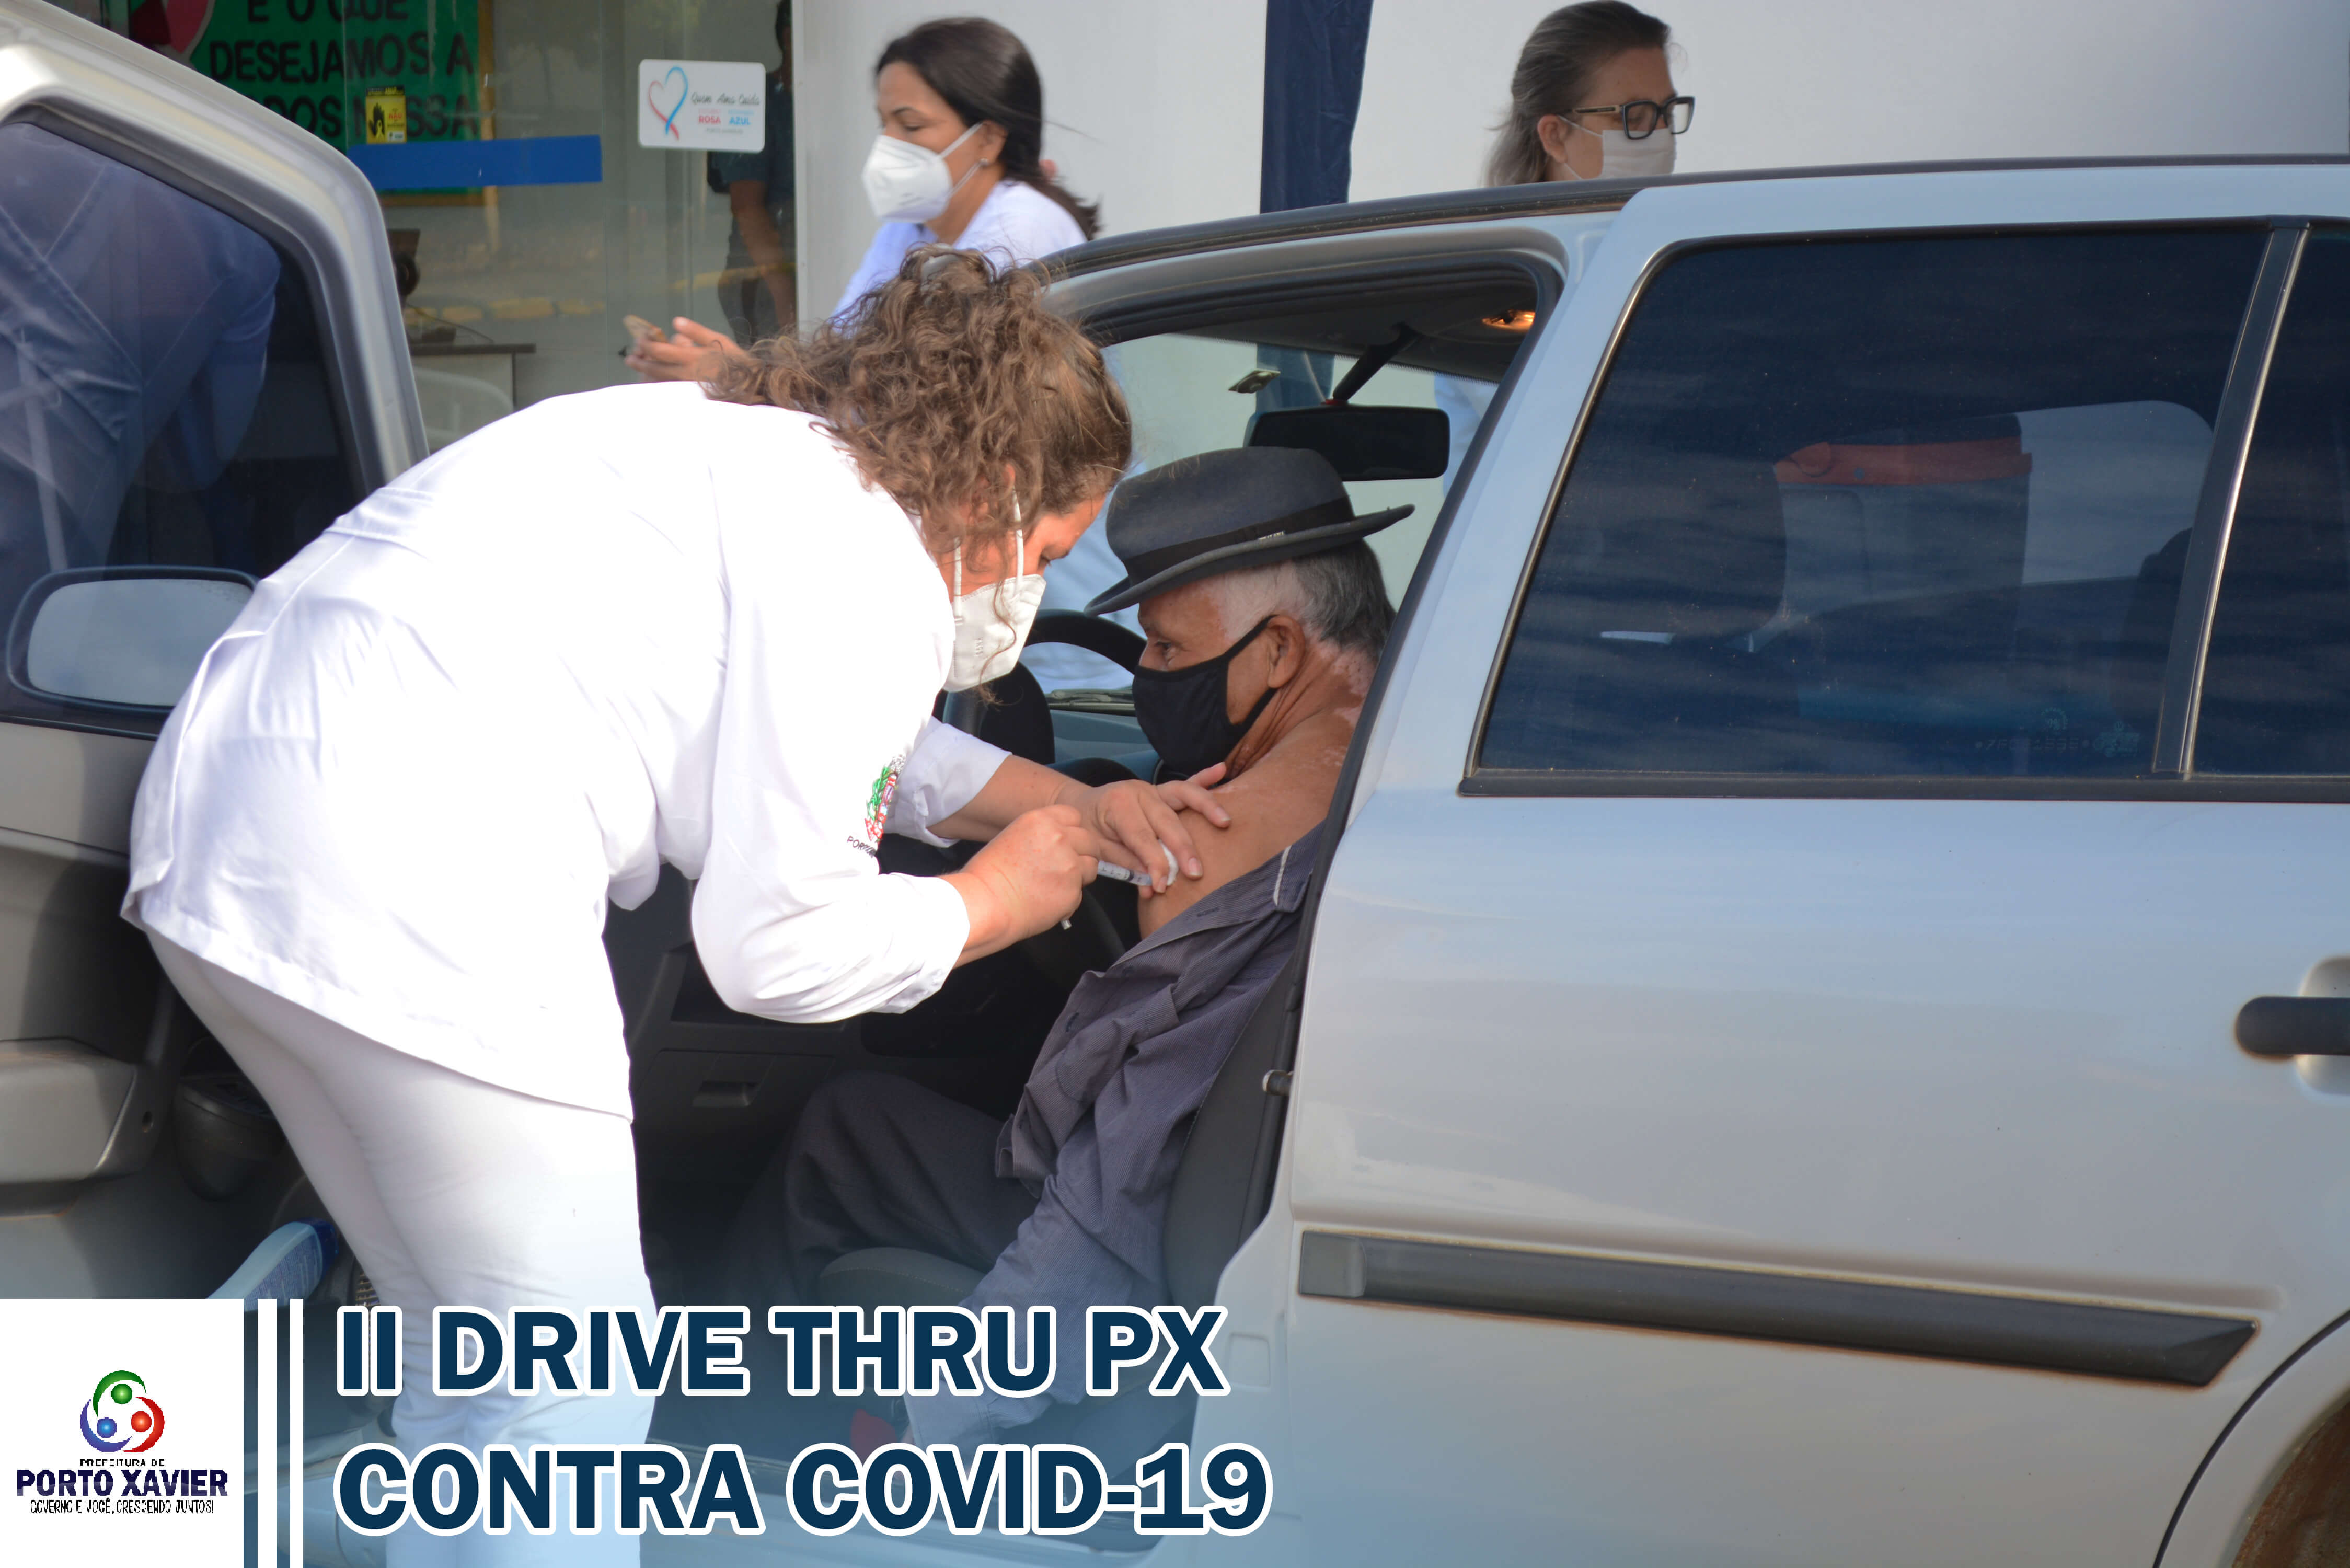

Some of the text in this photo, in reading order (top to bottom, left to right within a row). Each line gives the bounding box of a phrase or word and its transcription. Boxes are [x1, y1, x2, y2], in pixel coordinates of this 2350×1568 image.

[210, 30, 474, 83] DESEJAMOS A
[698, 115, 752, 126] ROSA AZUL
